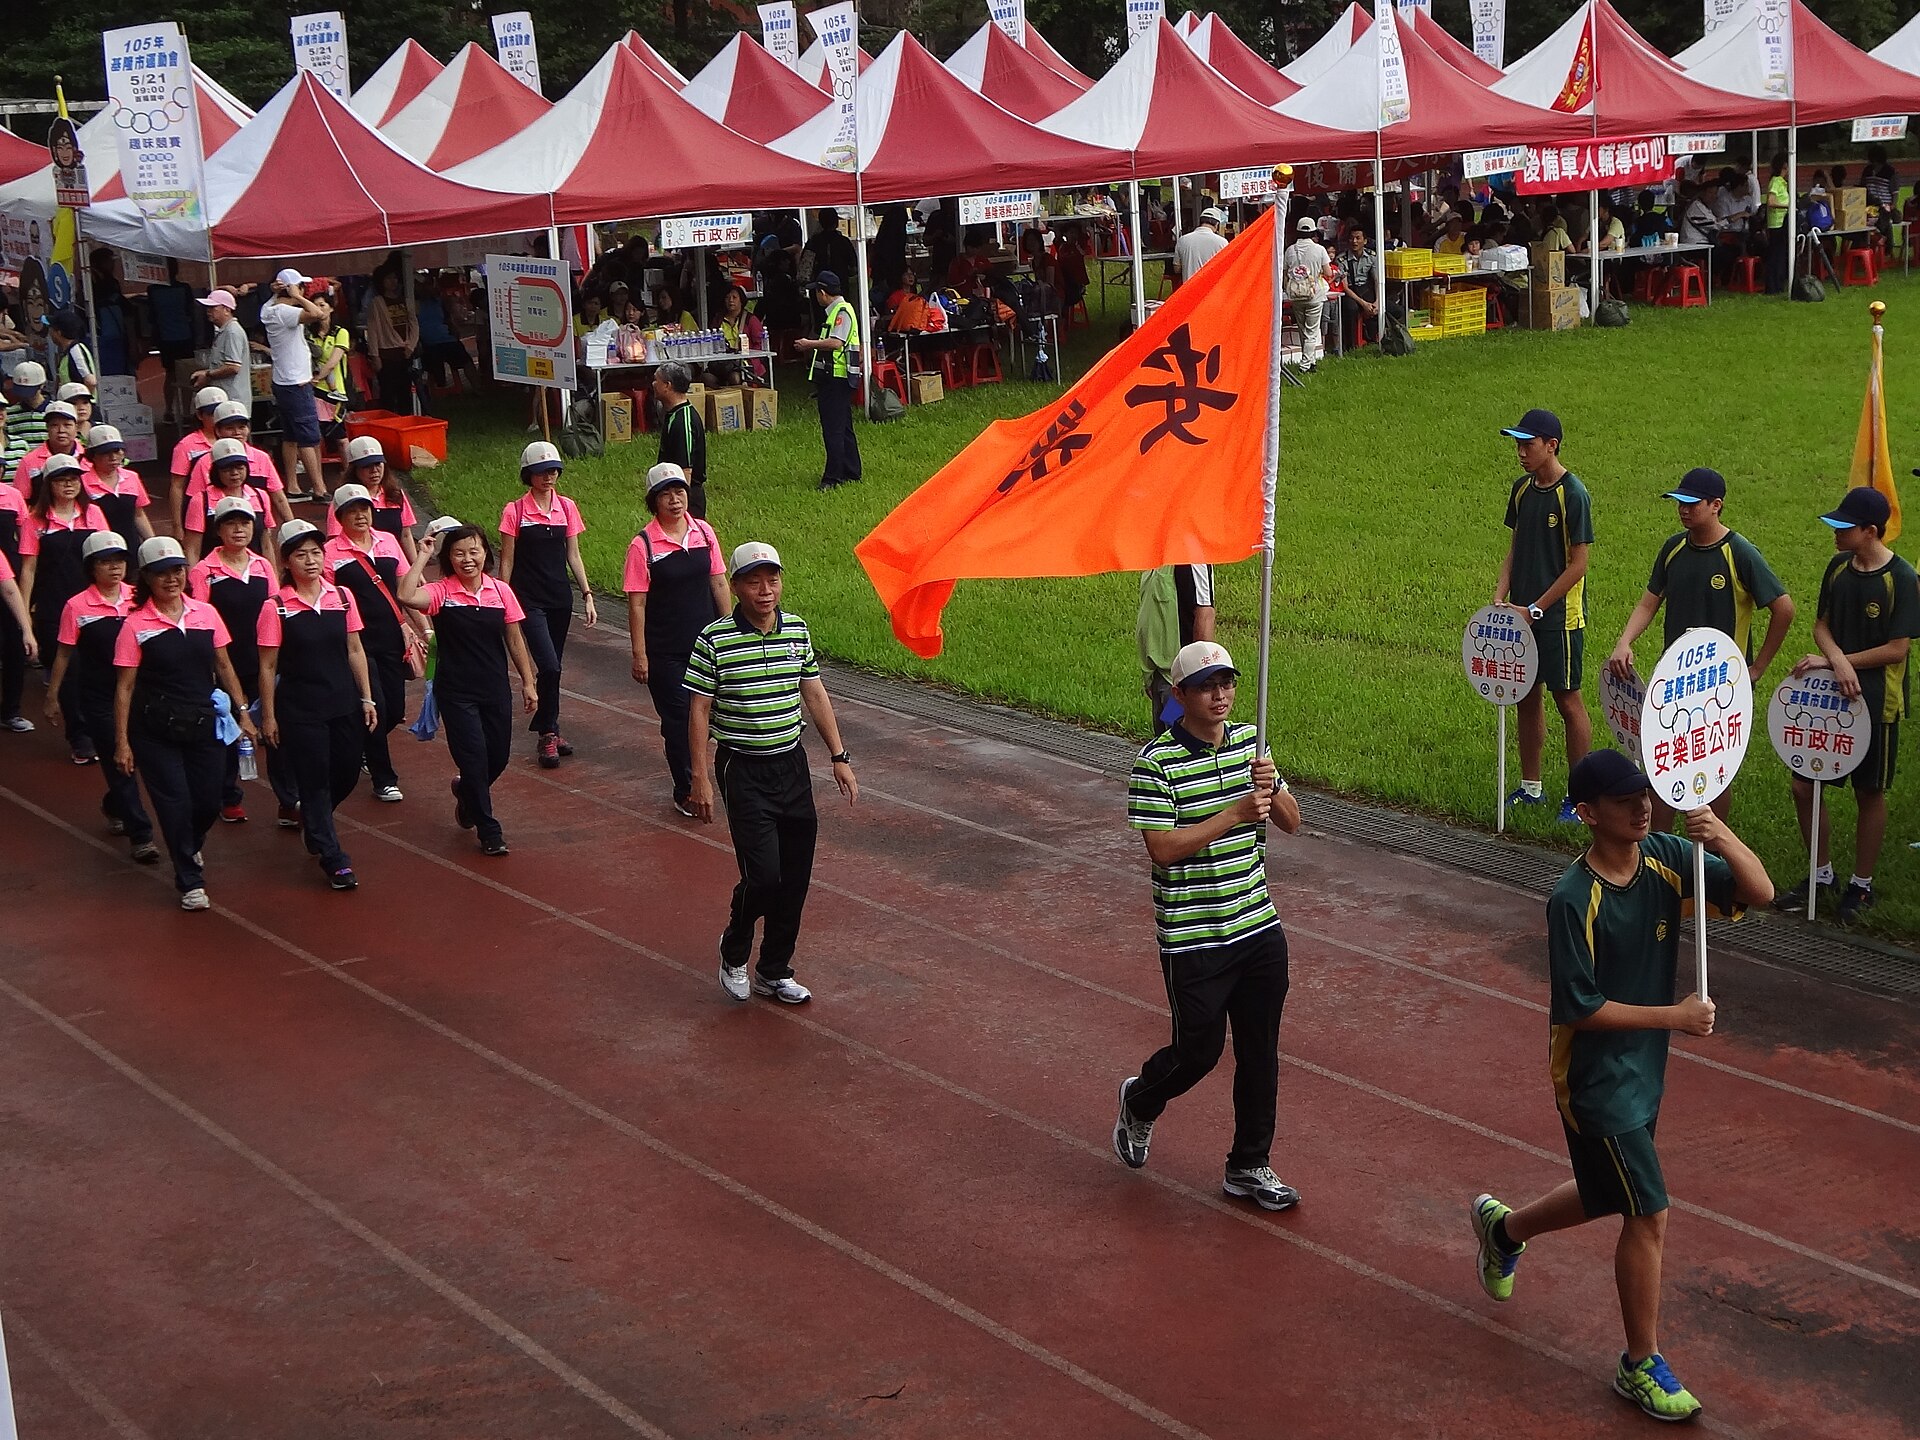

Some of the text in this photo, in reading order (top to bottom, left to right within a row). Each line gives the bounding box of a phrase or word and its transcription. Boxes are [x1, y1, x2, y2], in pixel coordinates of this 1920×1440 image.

[305, 21, 331, 32] 105年
[824, 15, 847, 29] 105年
[124, 36, 164, 53] 105年
[309, 46, 332, 56] 5/21
[111, 51, 178, 72] 基隆市運動會
[130, 73, 166, 86] 5/21
[132, 85, 165, 95] 09:00
[1523, 137, 1666, 184] 後備軍人輔導中心
[984, 202, 1032, 220] 基隆港務分公司
[692, 227, 739, 244] 市政府
[1487, 612, 1514, 626] 105年
[1477, 624, 1522, 644] 基隆市運動會
[1677, 641, 1717, 671] 105年
[1471, 656, 1526, 684] 籌備主任
[1663, 661, 1729, 704] 基隆市運動會
[1804, 677, 1840, 693] 105年
[1790, 690, 1851, 713] 基隆市運動會
[1654, 712, 1742, 776] 安樂區公所
[1783, 726, 1855, 756] 市政府
